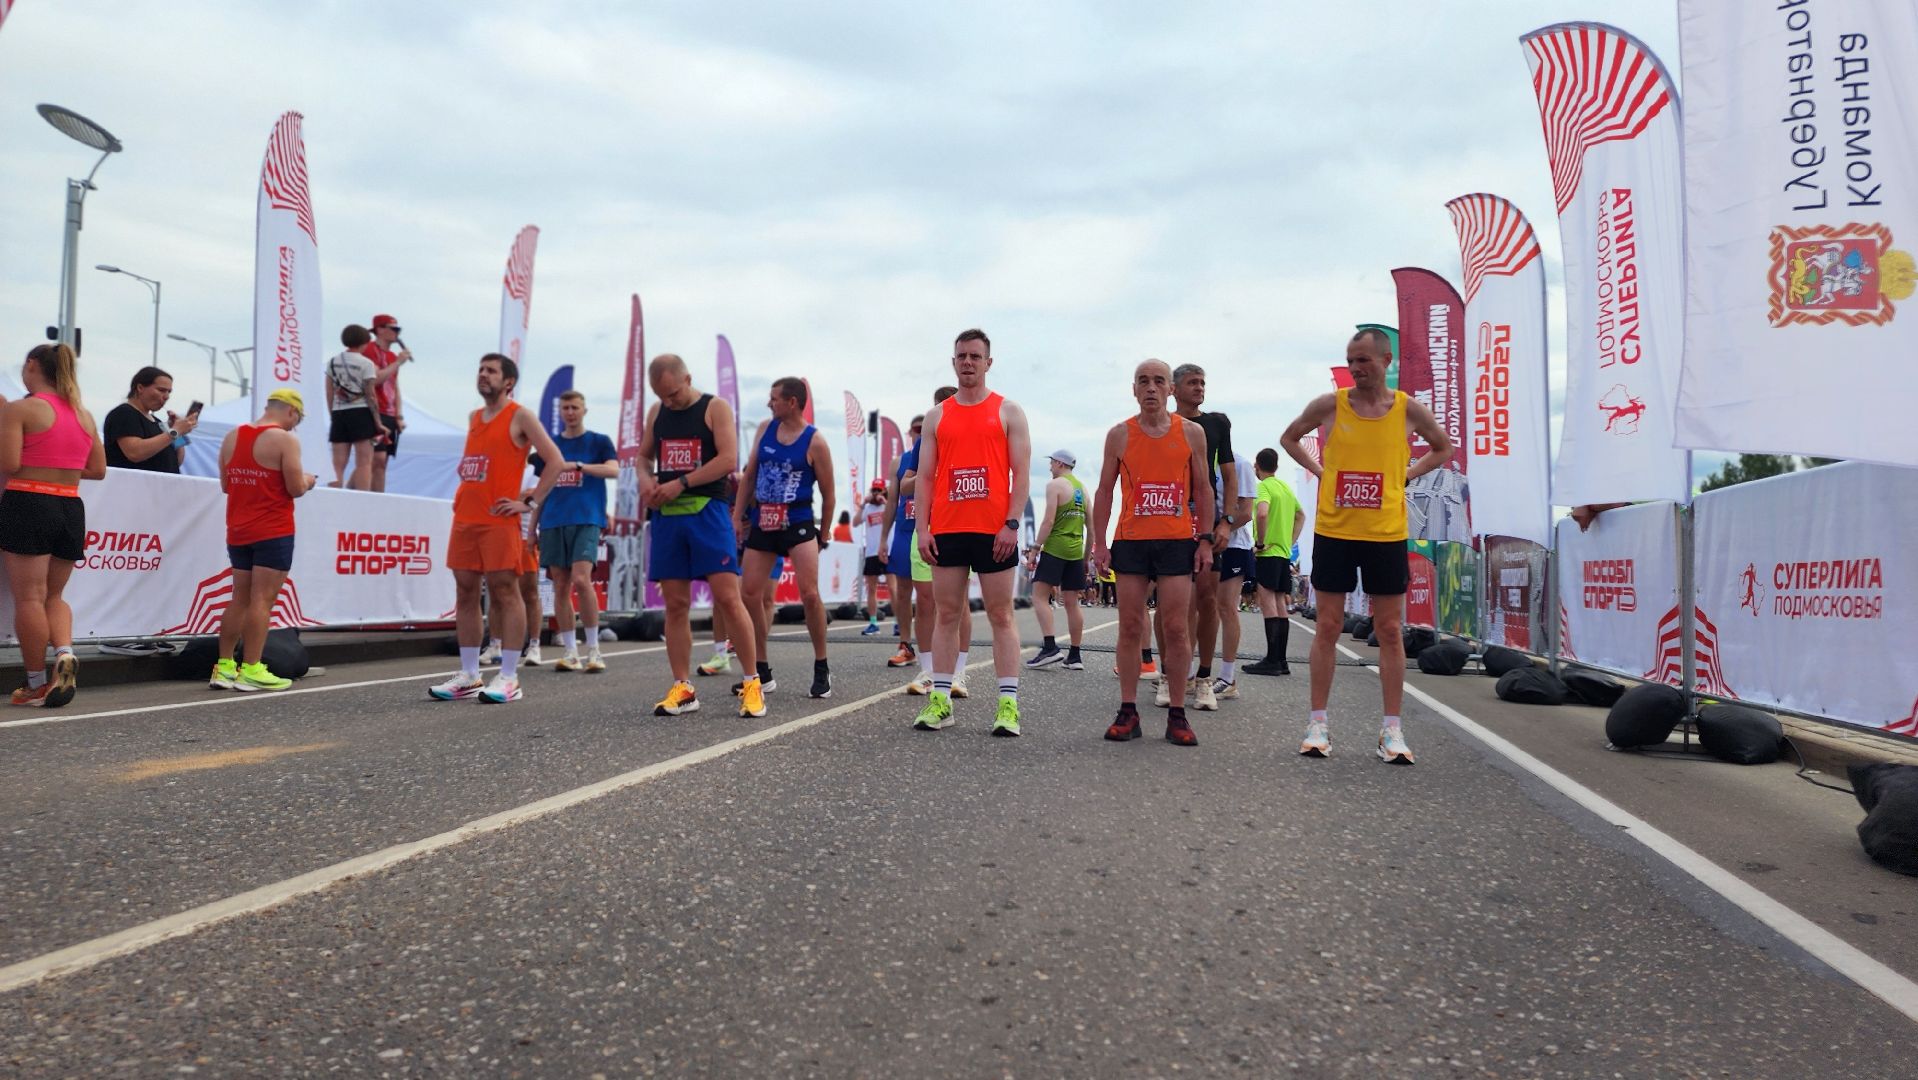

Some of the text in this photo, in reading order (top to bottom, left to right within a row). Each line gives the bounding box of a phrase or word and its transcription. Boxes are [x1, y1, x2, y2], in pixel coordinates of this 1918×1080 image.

[667, 450, 691, 465] 2128
[955, 477, 985, 493] 2080
[1343, 483, 1379, 500] 2052
[1142, 492, 1174, 508] 2046
[83, 530, 163, 553] РЛИГА
[74, 554, 162, 571] ОСКОВЬЯ
[1773, 558, 1883, 591] СУПЕРЛИГА
[1774, 595, 1882, 620] ПОДМОСКОВЬЯ
